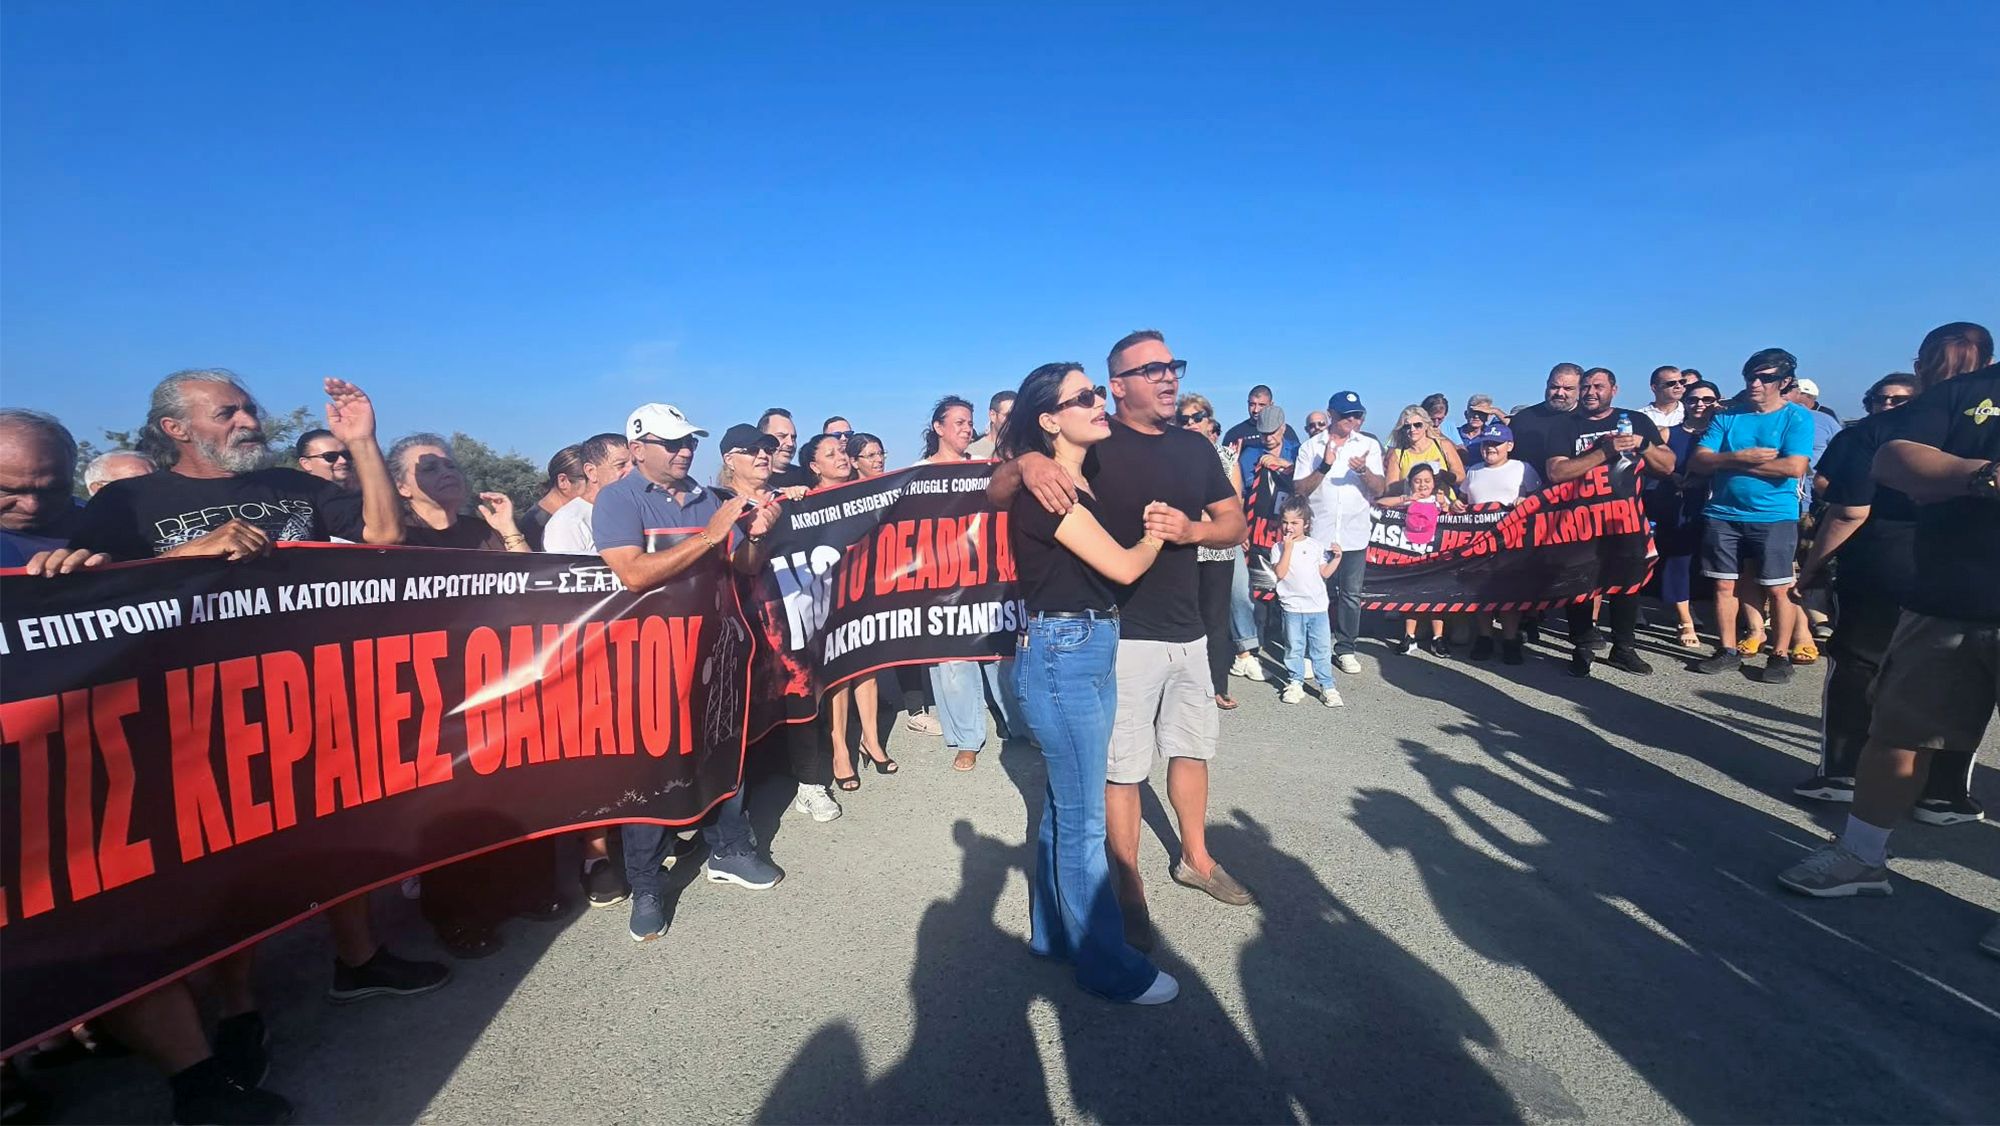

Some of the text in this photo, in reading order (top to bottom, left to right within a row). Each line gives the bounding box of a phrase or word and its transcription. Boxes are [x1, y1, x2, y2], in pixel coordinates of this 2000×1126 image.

[790, 506, 841, 530] AKROTIRI
[902, 479, 948, 496] TRUGGLE
[1534, 497, 1641, 547] AKROTIRI
[18, 598, 182, 652] ΕΠΙΤΡΟΠΗ
[190, 587, 271, 625] ΑΓΩΝΑ
[278, 578, 396, 613] ΚΑΤΟΙΚΩΝ
[403, 572, 530, 601] ΑΚΡΩΤΗΡΙΟΥ
[771, 544, 841, 651] NO
[837, 533, 870, 609] TO
[874, 512, 989, 597] DEADLY
[823, 606, 921, 666] AKROTIRI
[928, 600, 1017, 636] STANDS
[0, 615, 703, 928] ΤΙΣ ΚΕΡΑΙΕΣ ΘΑΝΑΤΟΥ
